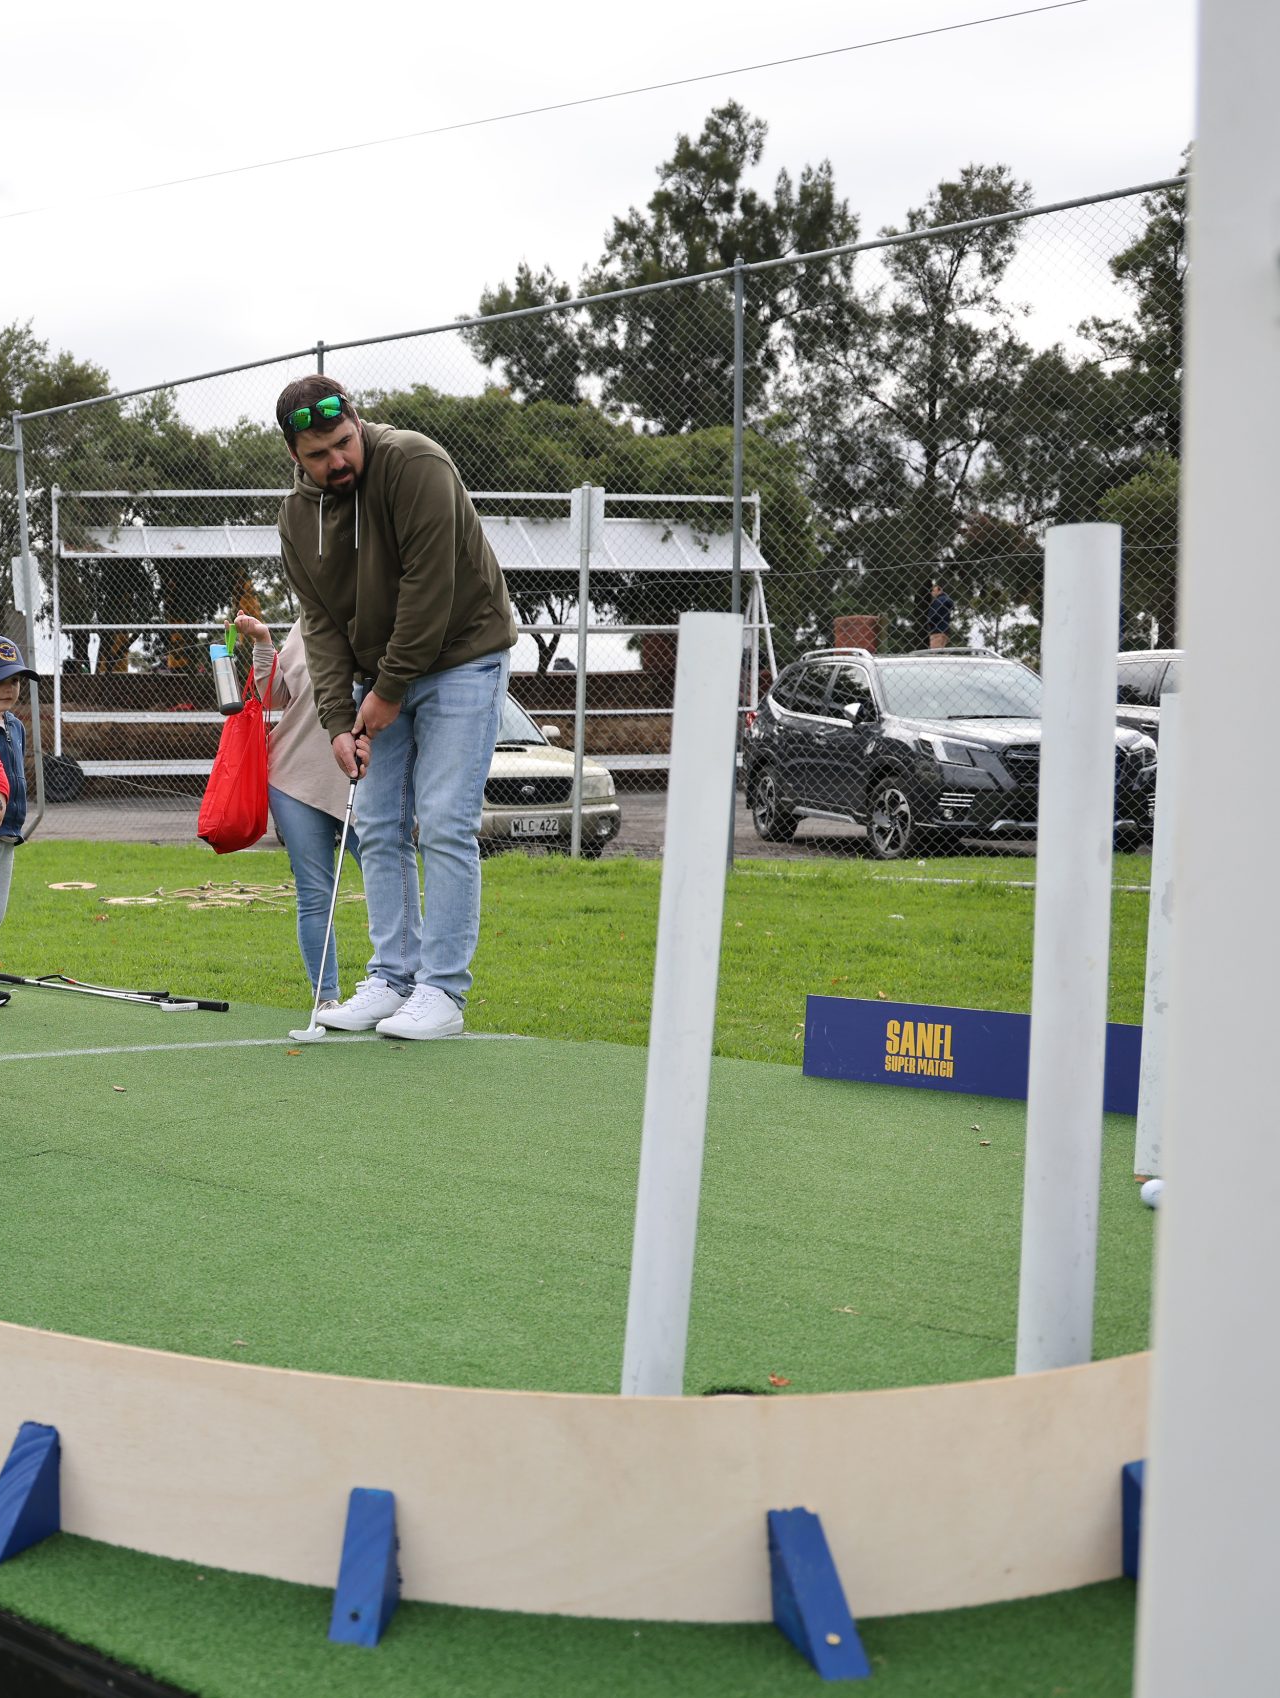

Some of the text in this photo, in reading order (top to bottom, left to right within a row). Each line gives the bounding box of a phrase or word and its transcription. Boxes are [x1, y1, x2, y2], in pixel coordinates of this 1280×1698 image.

[512, 819, 558, 833] WLC 422
[885, 1019, 954, 1061] SANFL
[884, 1054, 954, 1078] SUPER MATCH
